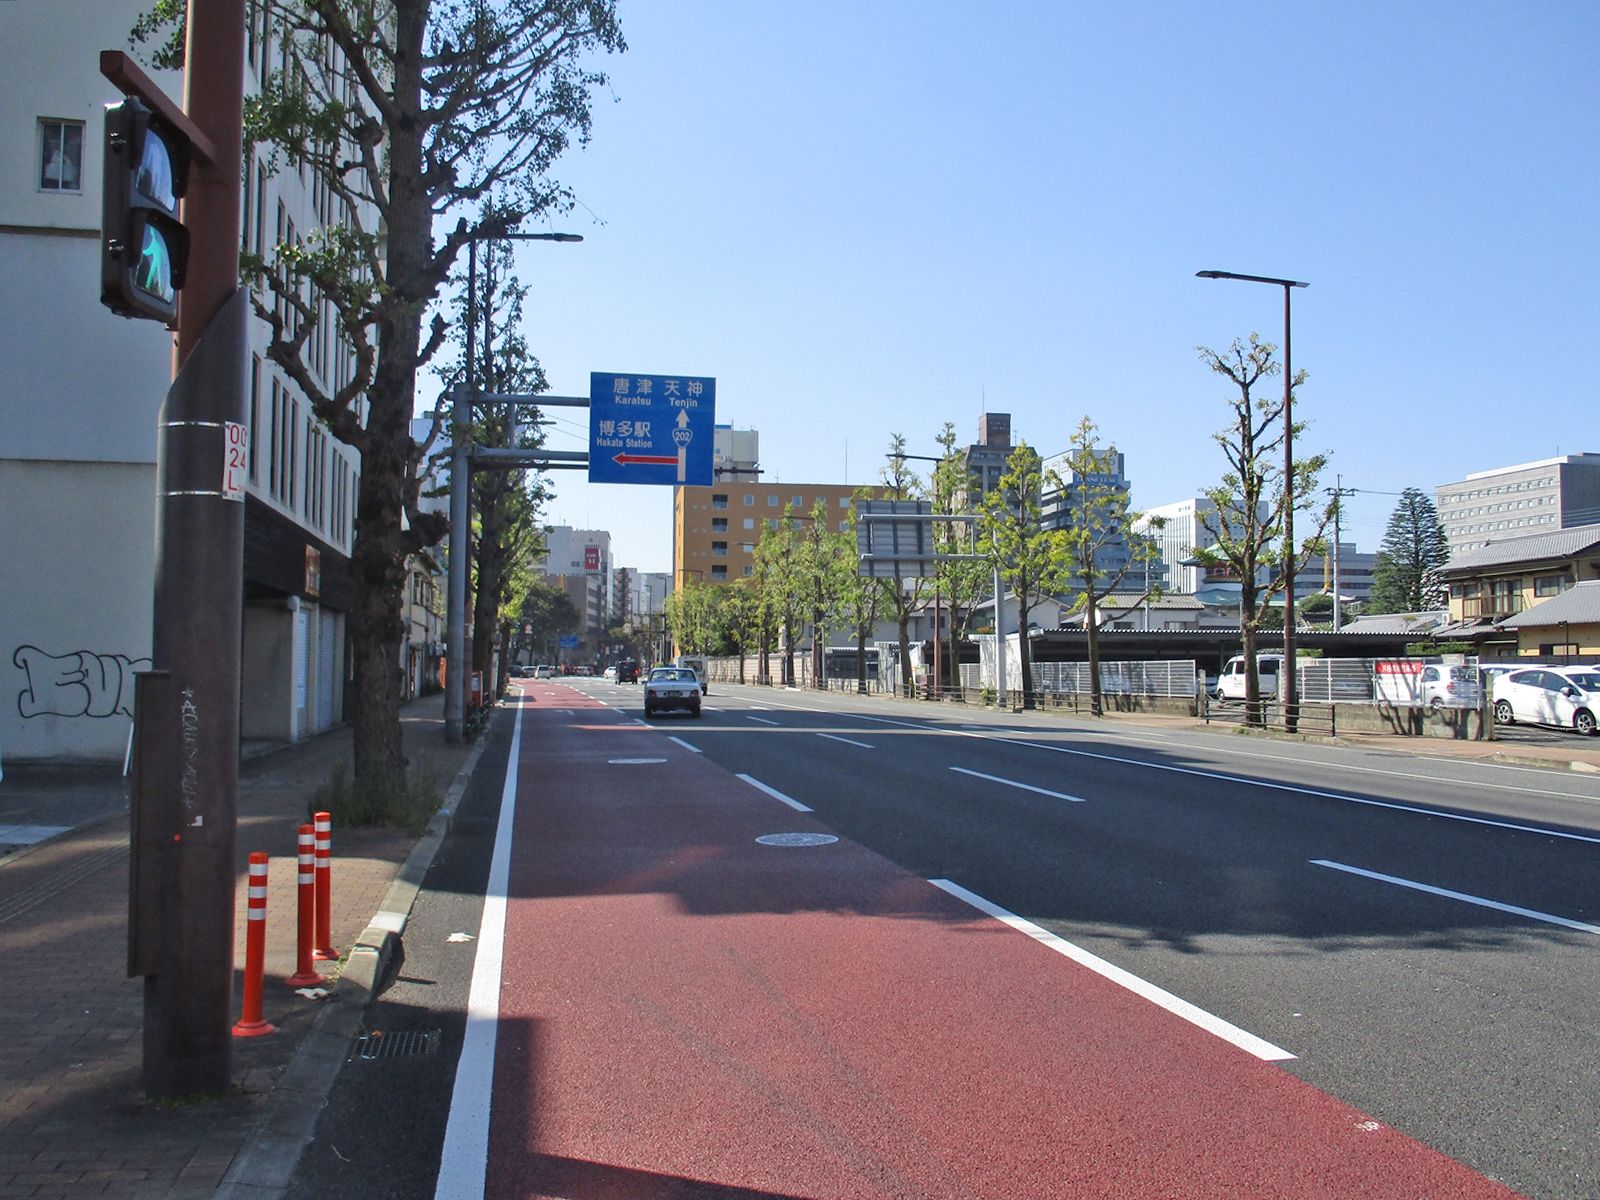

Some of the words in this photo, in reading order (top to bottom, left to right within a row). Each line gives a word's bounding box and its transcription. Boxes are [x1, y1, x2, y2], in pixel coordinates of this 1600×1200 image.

[613, 378, 653, 395] 唐津
[664, 380, 703, 397] 天神
[615, 395, 651, 406] Karatsu
[669, 397, 698, 408] Tenjin
[599, 420, 651, 437] 博多駅
[675, 431, 690, 441] 202
[596, 438, 623, 448] Hakata
[625, 439, 653, 449] Station
